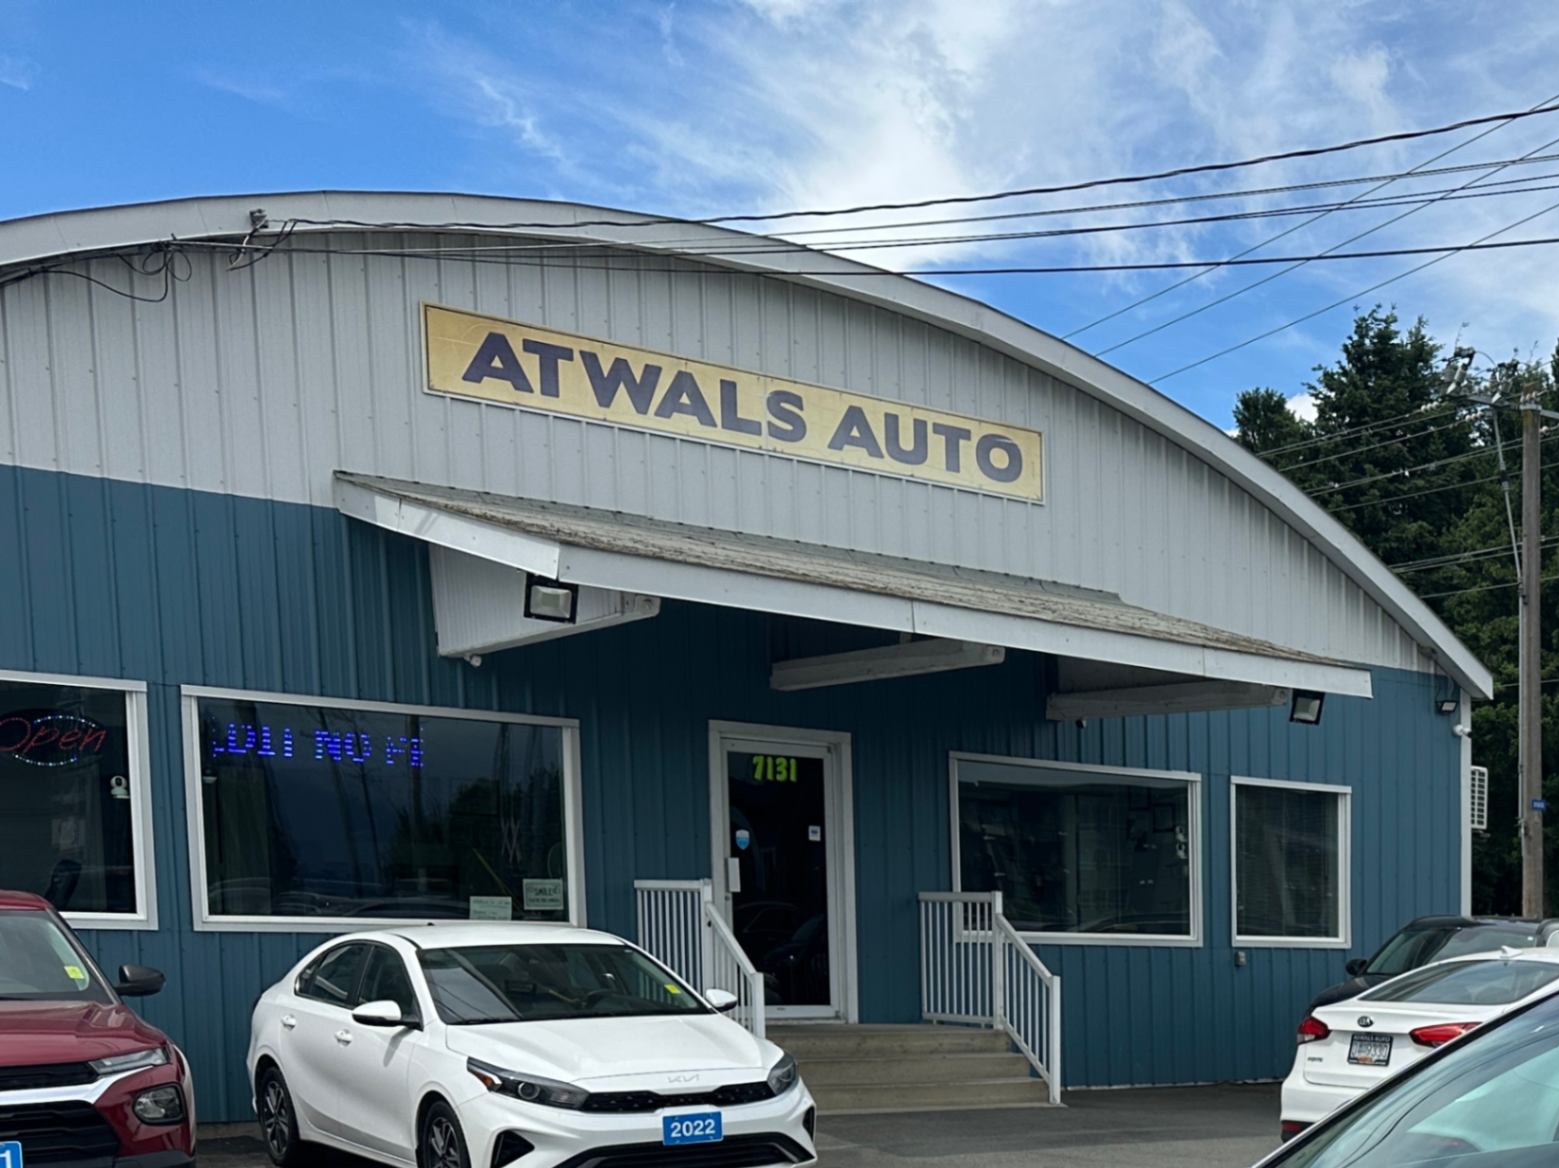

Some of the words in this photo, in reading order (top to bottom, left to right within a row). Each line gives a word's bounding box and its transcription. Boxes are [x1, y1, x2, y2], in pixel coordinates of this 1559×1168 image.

[462, 332, 807, 443] ATWALS
[828, 405, 1023, 484] AUTO
[0, 717, 107, 753] Open
[752, 755, 798, 782] 7131
[670, 1118, 716, 1138] 2022
